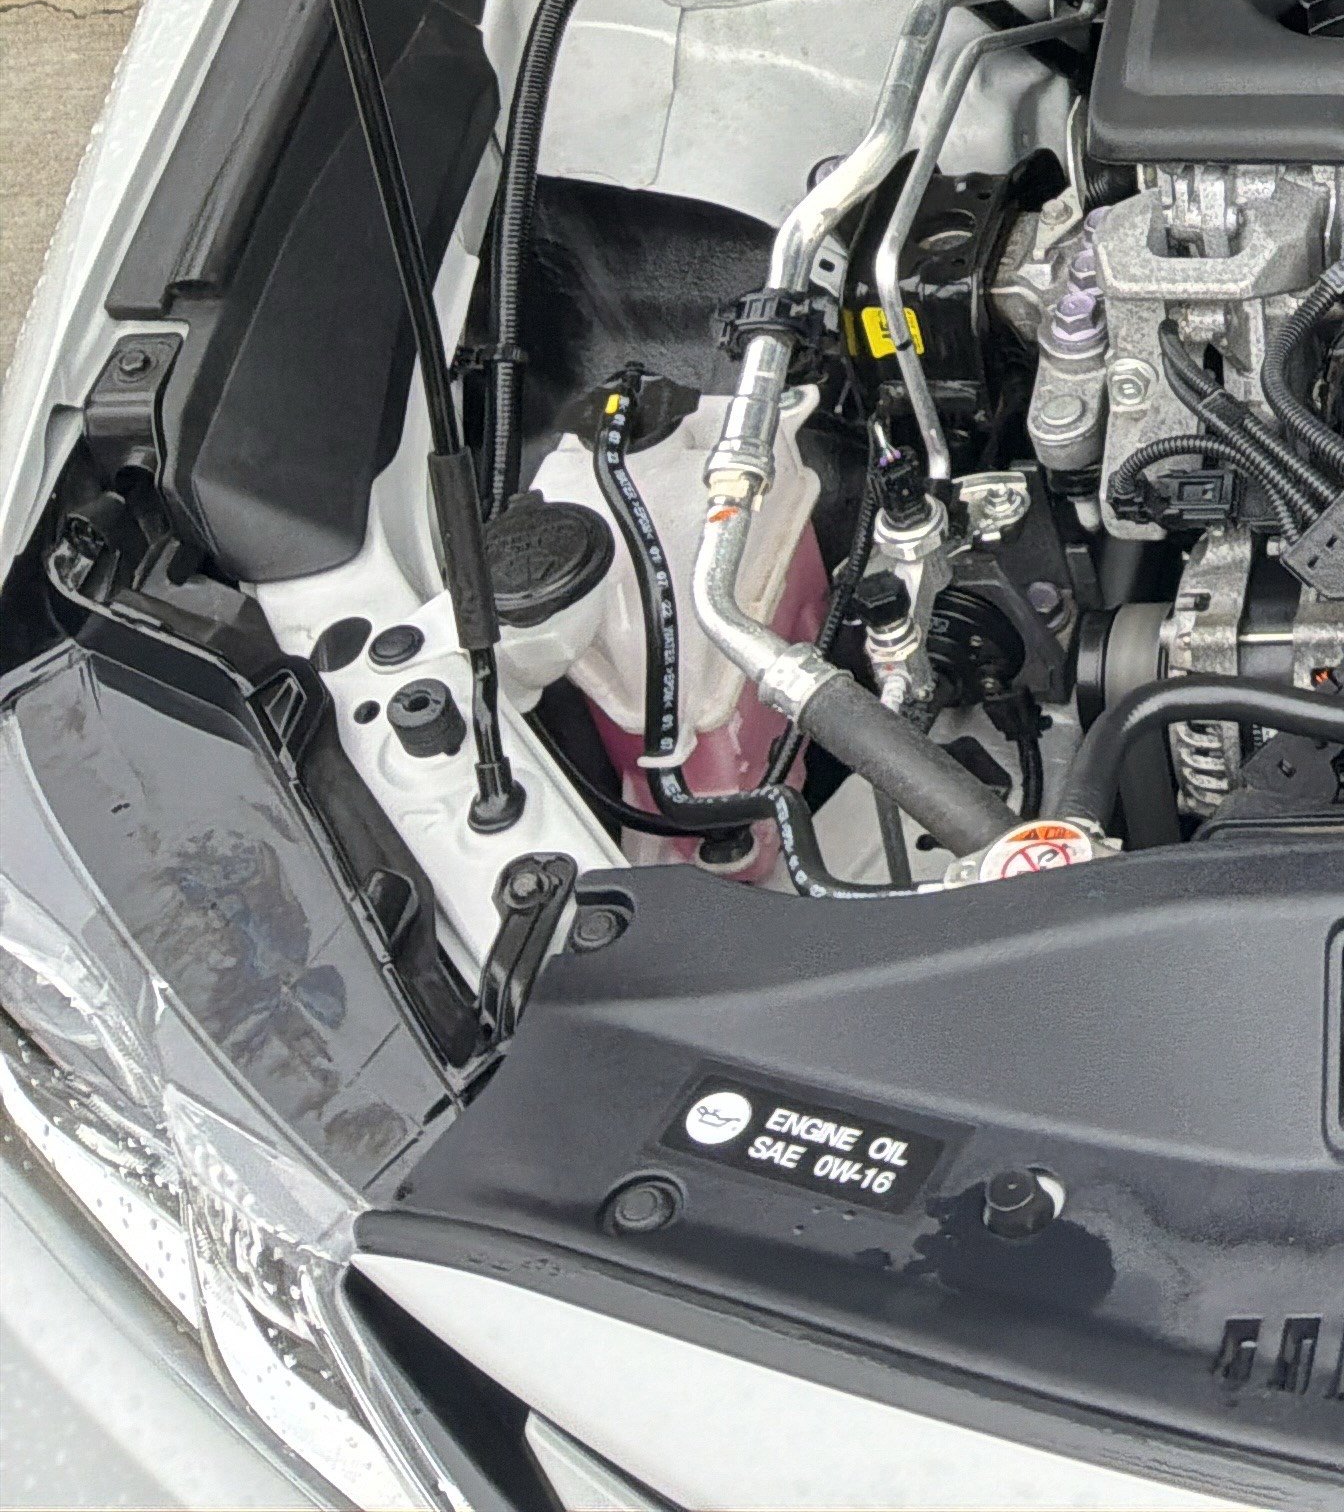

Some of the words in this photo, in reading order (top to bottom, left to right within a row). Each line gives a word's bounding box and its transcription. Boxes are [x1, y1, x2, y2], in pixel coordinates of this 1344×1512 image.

[663, 626, 676, 665] WATER
[748, 1136, 807, 1169] SAE
[813, 1154, 896, 1194] 0W-16
[765, 1108, 863, 1151] ENGINE
[868, 1137, 908, 1167] OIL
